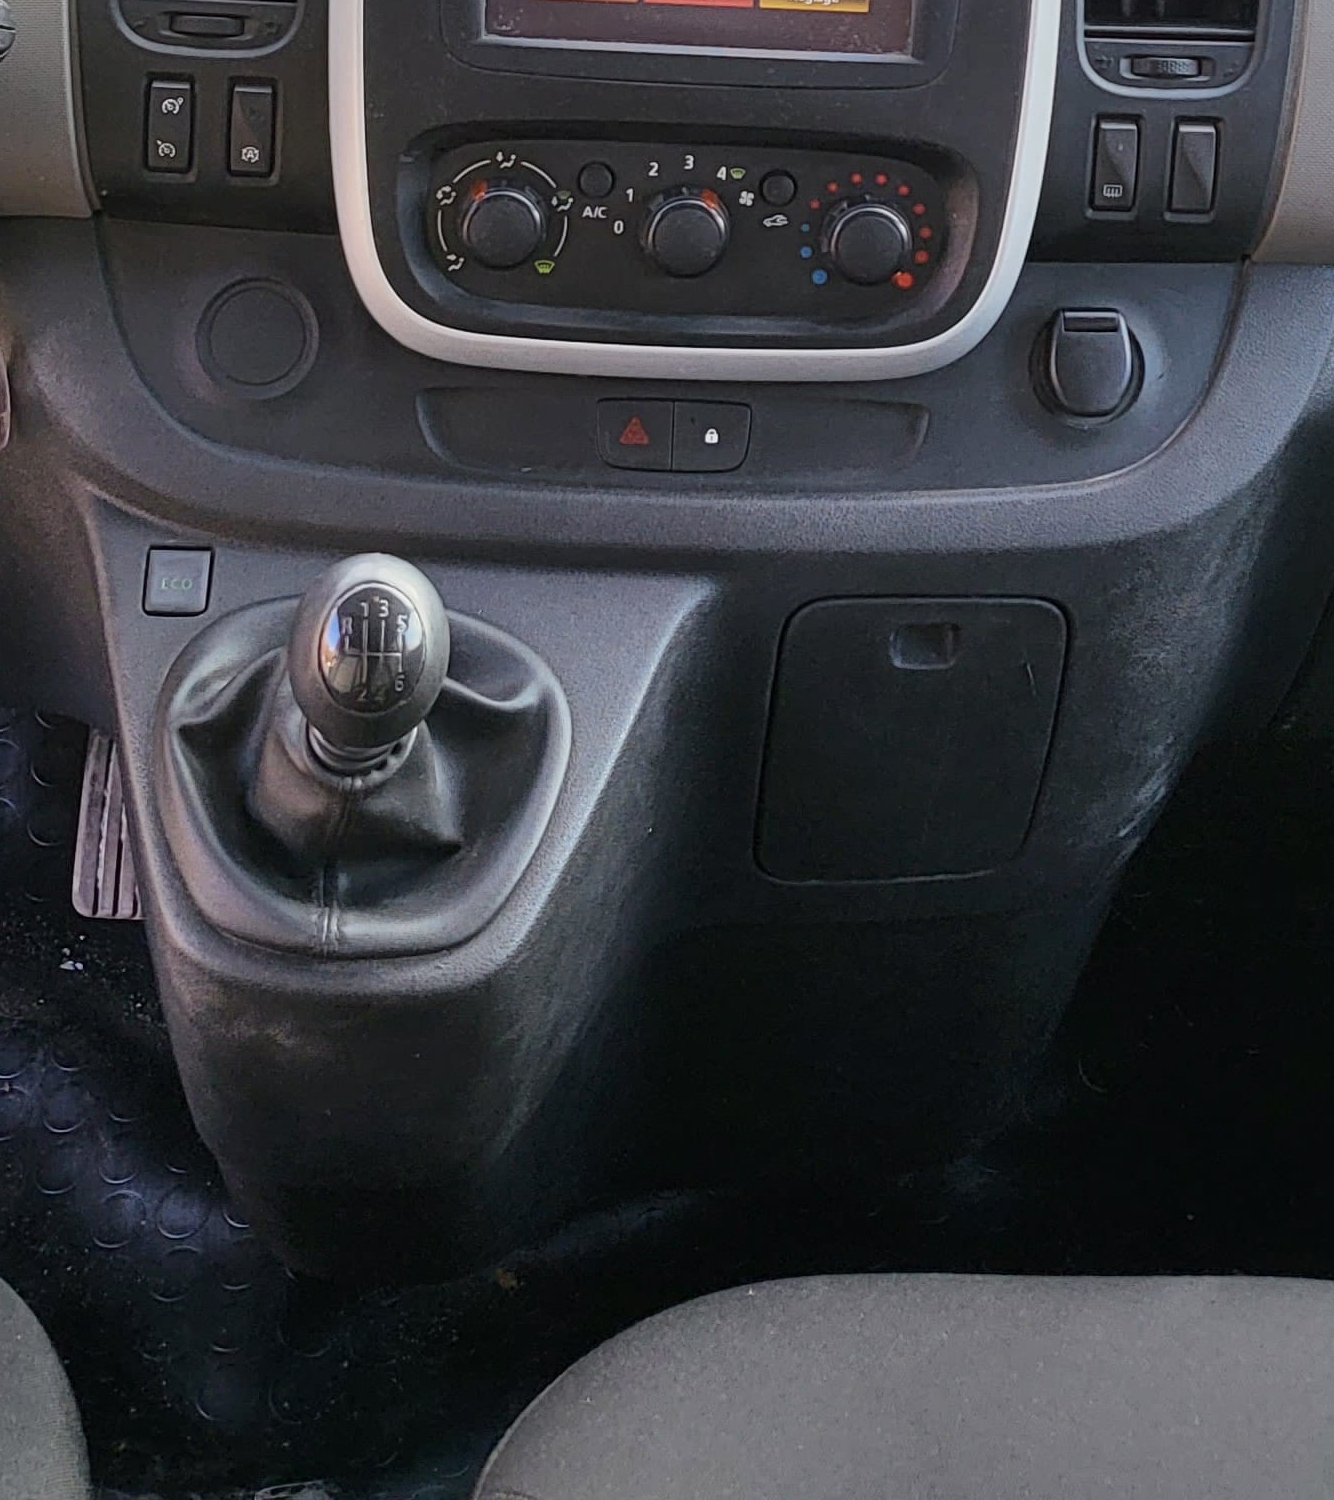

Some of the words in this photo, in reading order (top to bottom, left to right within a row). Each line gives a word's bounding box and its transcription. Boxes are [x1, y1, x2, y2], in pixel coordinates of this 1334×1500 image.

[648, 162, 659, 177] 2
[683, 155, 694, 170] 3
[717, 166, 727, 181] 4
[625, 188, 634, 203] 1
[582, 206, 608, 219] A/C
[161, 578, 194, 591] ECO
[360, 601, 370, 618] 1
[378, 599, 389, 618] 3
[396, 614, 409, 633] 5
[394, 674, 406, 692] 6
